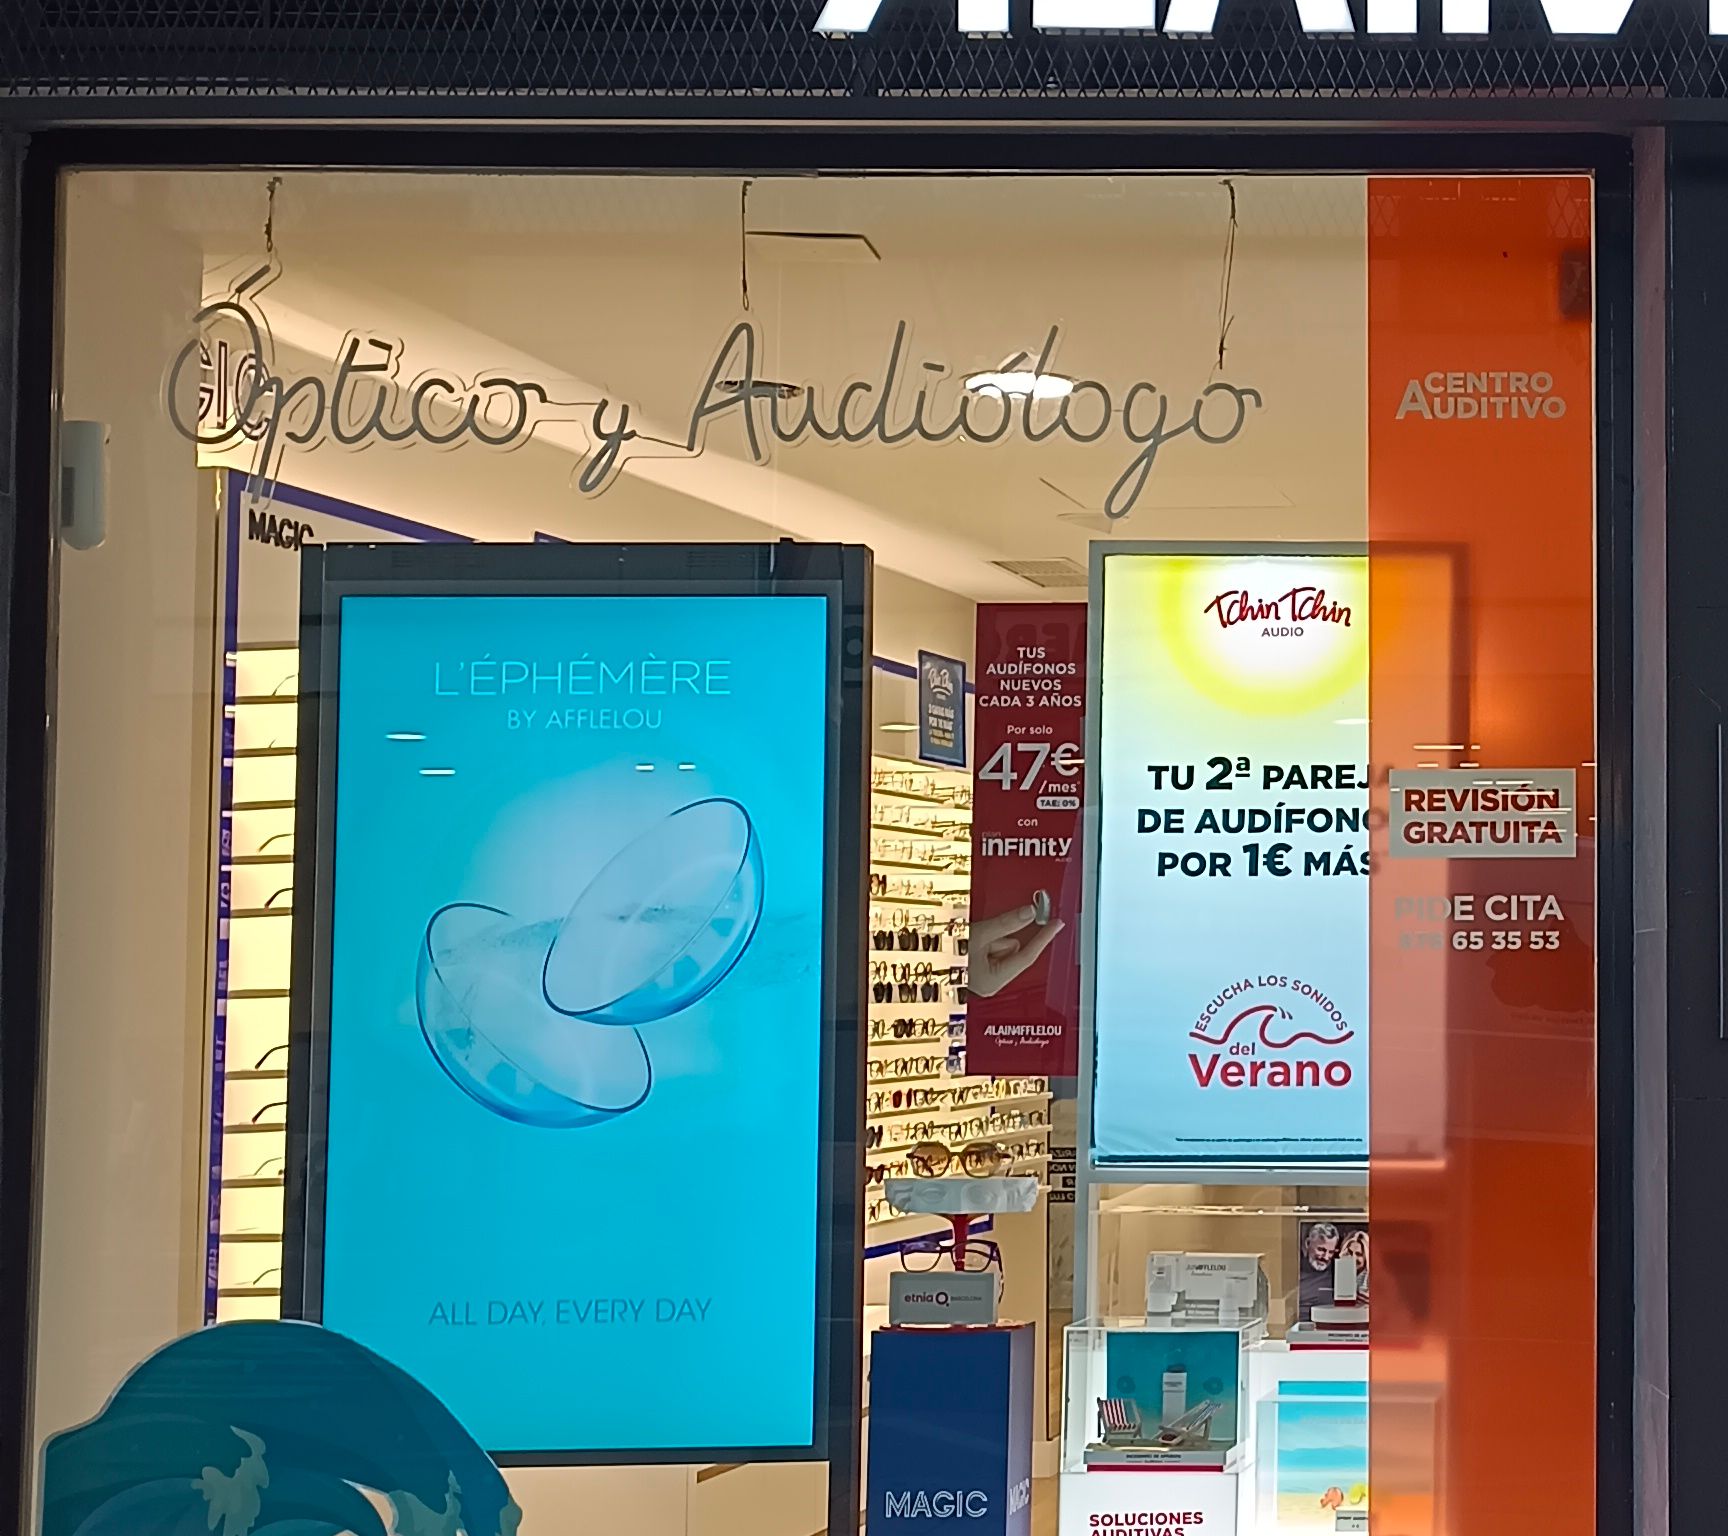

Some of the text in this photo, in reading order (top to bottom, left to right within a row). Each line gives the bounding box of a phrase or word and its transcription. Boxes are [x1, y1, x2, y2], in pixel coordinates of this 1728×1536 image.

[1423, 371, 1554, 394] CENTRO
[1395, 379, 1567, 420] AUDITIVO
[579, 397, 637, 493] y
[687, 319, 1262, 519] Audiólogo
[1203, 586, 1352, 629] Tchin Tchin
[1261, 626, 1305, 638] AUDIO
[1016, 646, 1046, 659] TUS
[434, 652, 731, 696] L'ÉPHÉMÈRE
[985, 660, 1076, 675] AUDÍFONOS
[999, 679, 1062, 692] NUEVOS
[978, 692, 1082, 708] CADA 3 AÑOS
[507, 708, 662, 730] BY AFFLELOU
[1006, 724, 1053, 736] Por solo
[978, 742, 1081, 791] 47€
[1147, 765, 1196, 791] TU
[1205, 756, 1251, 791] 2ª
[1061, 799, 1077, 808] 0%
[1404, 783, 1560, 812] REVISIÓN
[1017, 818, 1039, 827] con
[1137, 808, 1185, 834] DE
[1402, 820, 1563, 844] GRATUITA
[1157, 842, 1381, 877] POR 1€ MÁS
[1394, 895, 1475, 921] PIDE
[1484, 894, 1565, 921] CITA
[1452, 930, 1484, 950] 65
[1491, 930, 1522, 950] 35
[1529, 930, 1560, 950] 53
[1194, 974, 1348, 1033] ESCUCHA LOS SONIDOS
[1228, 1041, 1256, 1056] del
[1187, 1053, 1353, 1088] Verano
[903, 1291, 934, 1303] etnia
[428, 1297, 713, 1326] ALL DAY, EVERY DAY
[885, 1490, 988, 1518] MAGIC
[1089, 1511, 1204, 1527] SOLUCIONES
